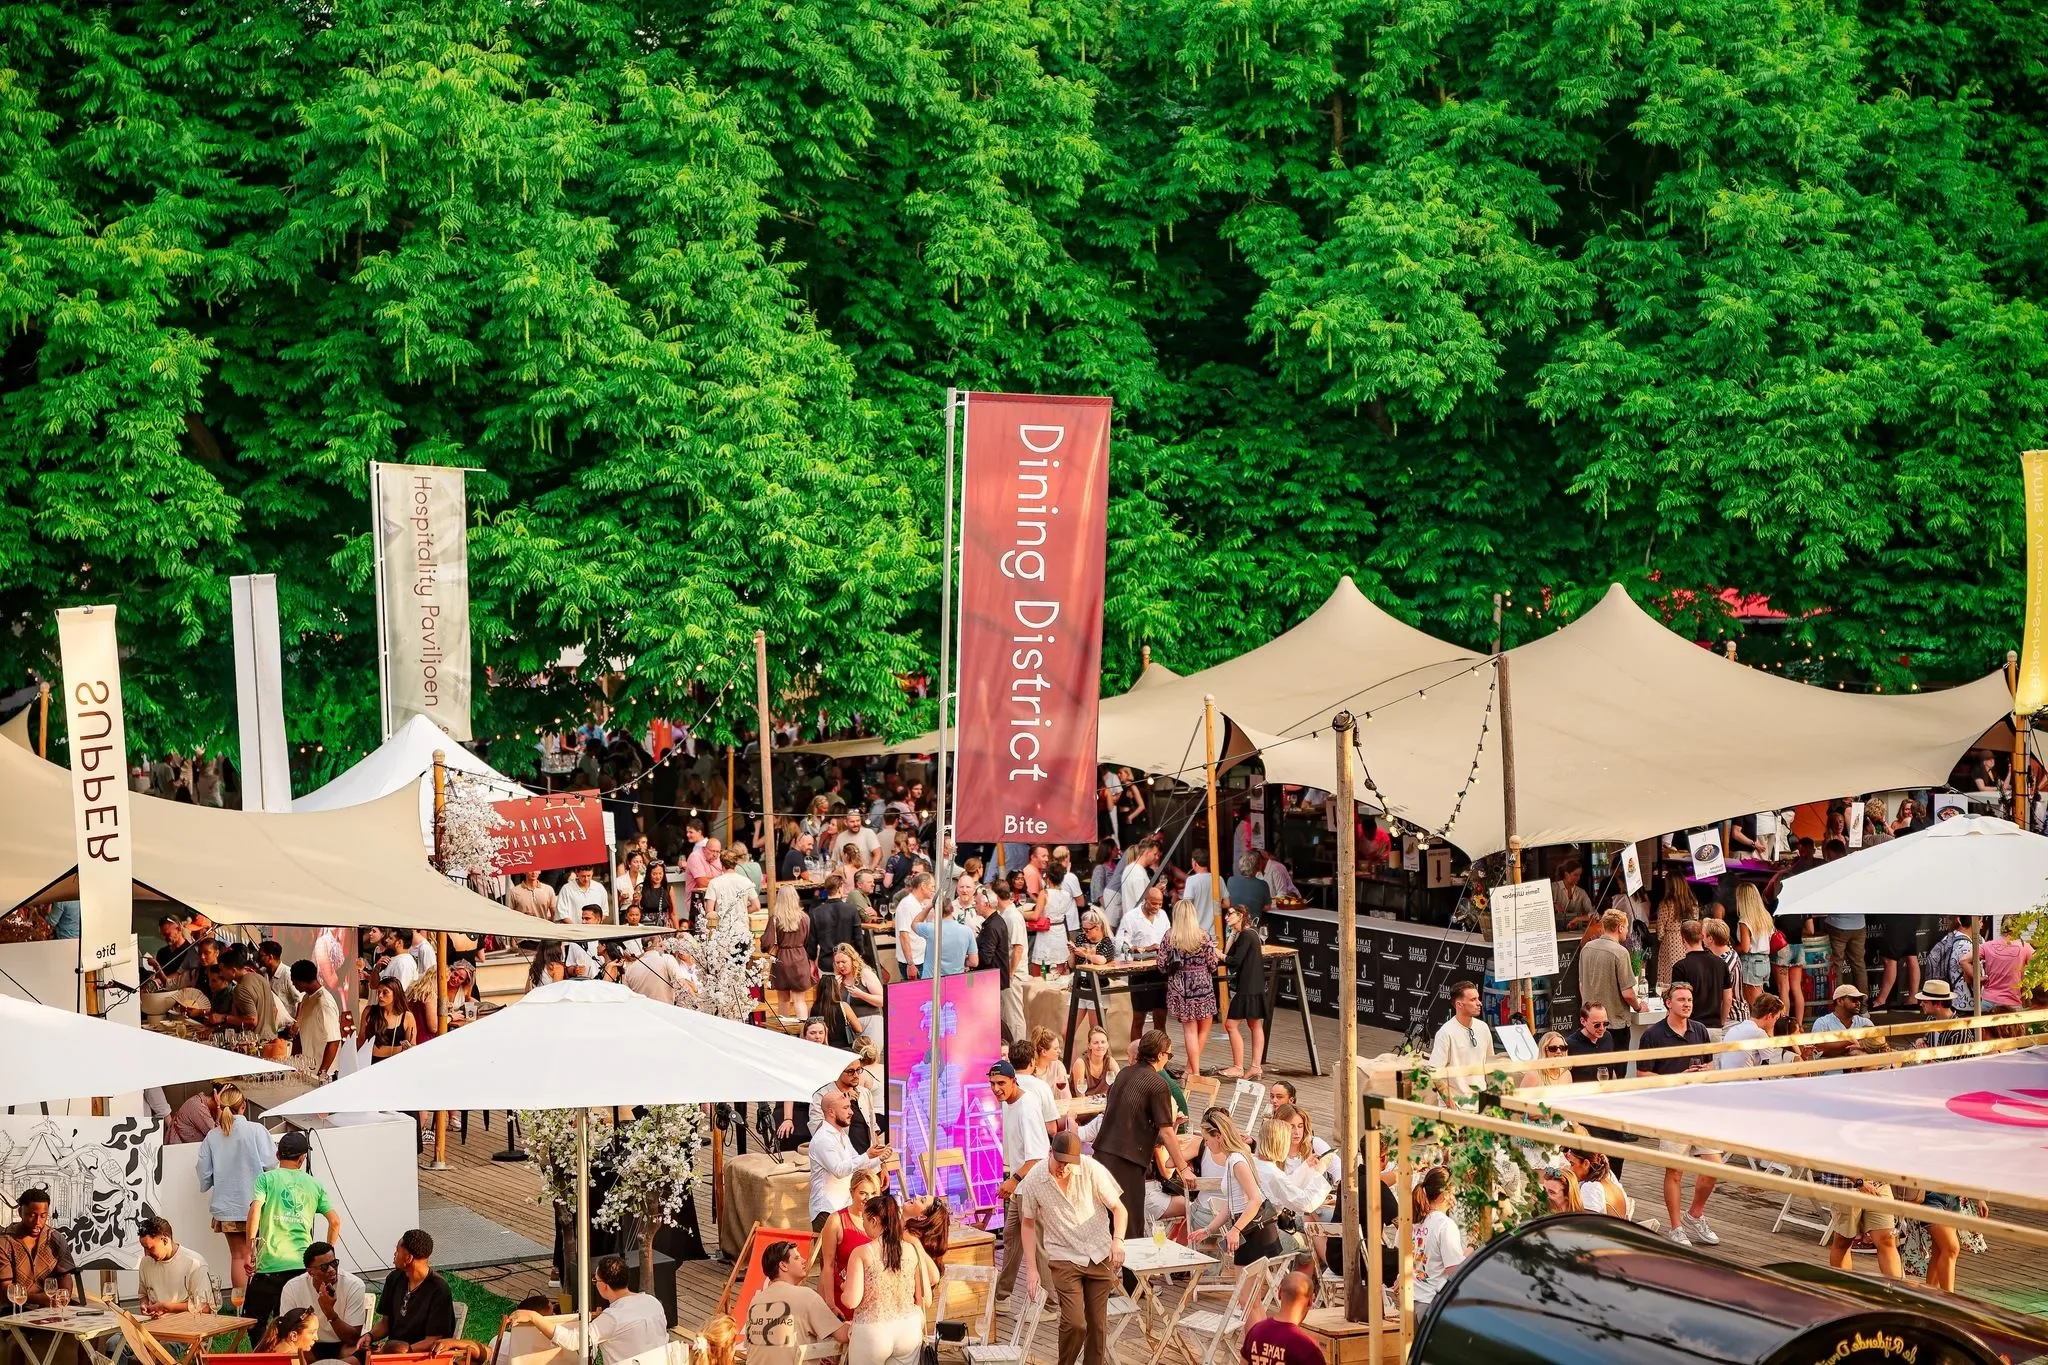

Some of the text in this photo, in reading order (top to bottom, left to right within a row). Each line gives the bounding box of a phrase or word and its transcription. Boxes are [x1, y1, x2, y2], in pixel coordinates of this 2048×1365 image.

[410, 476, 443, 707] Hospitality Paviljoen
[1000, 424, 1065, 782] Dining District
[1004, 814, 1048, 835] Bite
